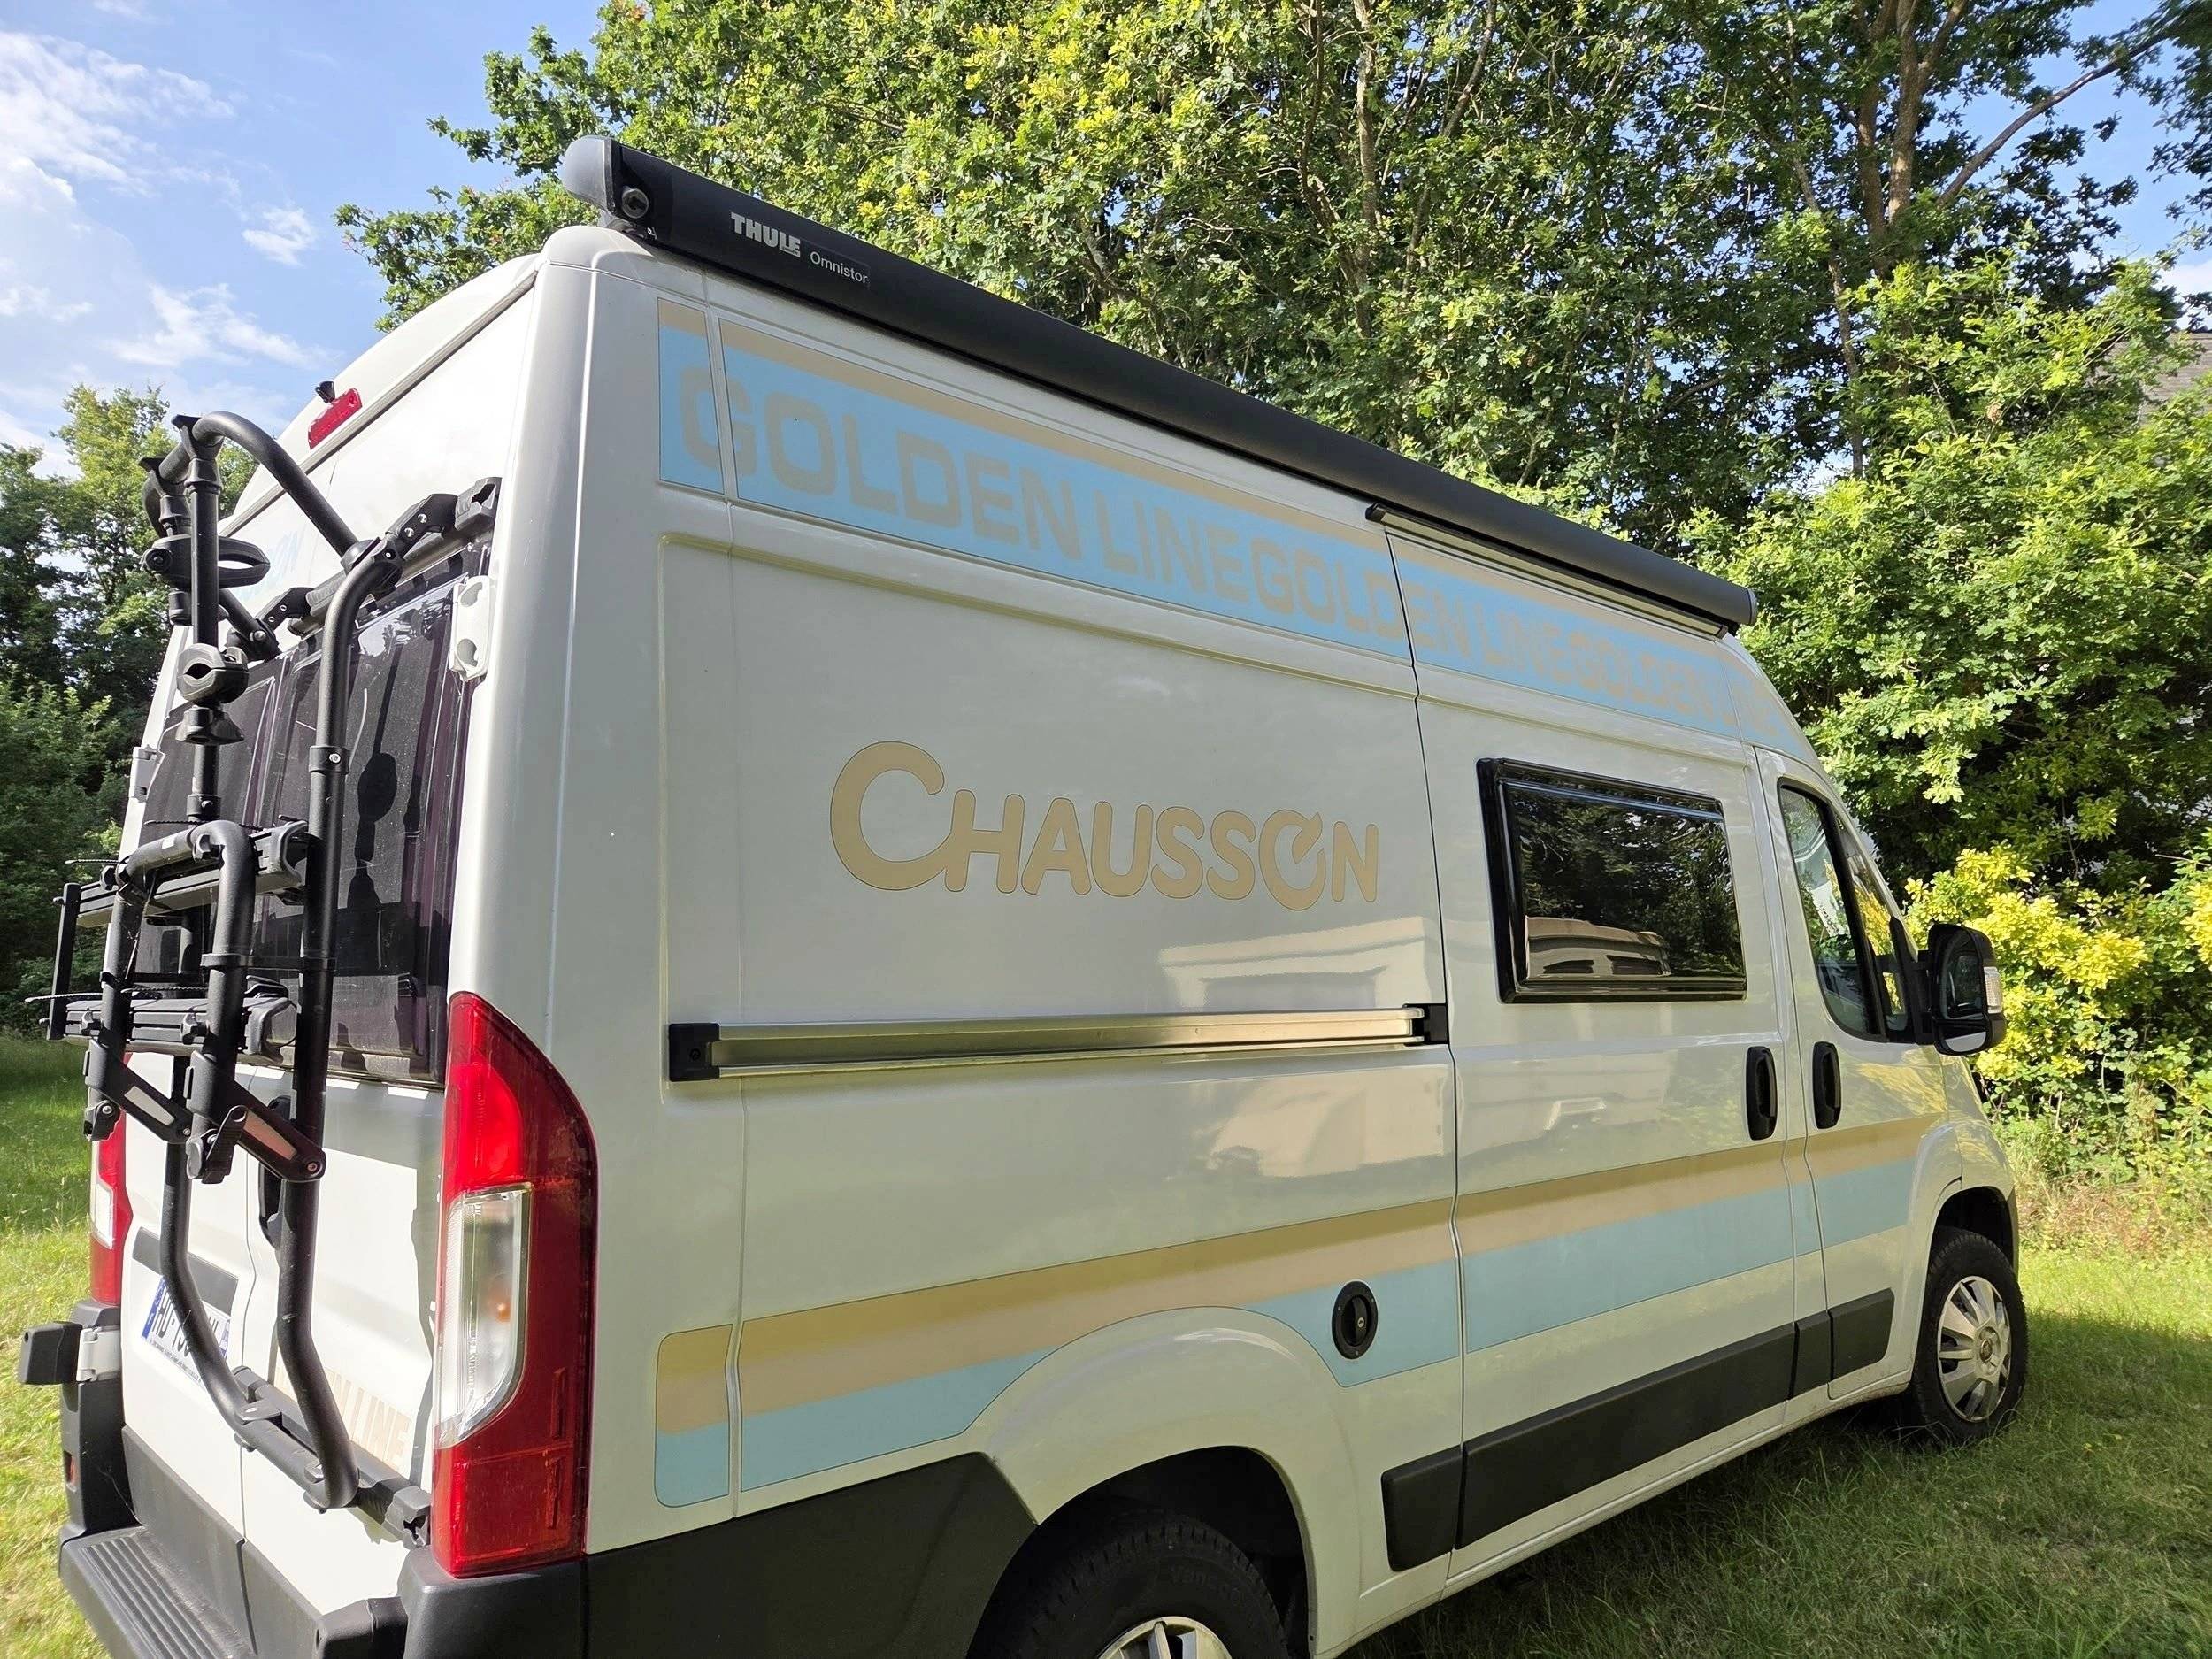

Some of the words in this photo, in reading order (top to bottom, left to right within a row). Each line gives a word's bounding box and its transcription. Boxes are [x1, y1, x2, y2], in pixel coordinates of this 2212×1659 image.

[731, 211, 801, 257] THULE
[810, 251, 868, 284] Omnistor
[679, 366, 1082, 559] GOLDEN
[830, 741, 1379, 911] CHAUSSON
